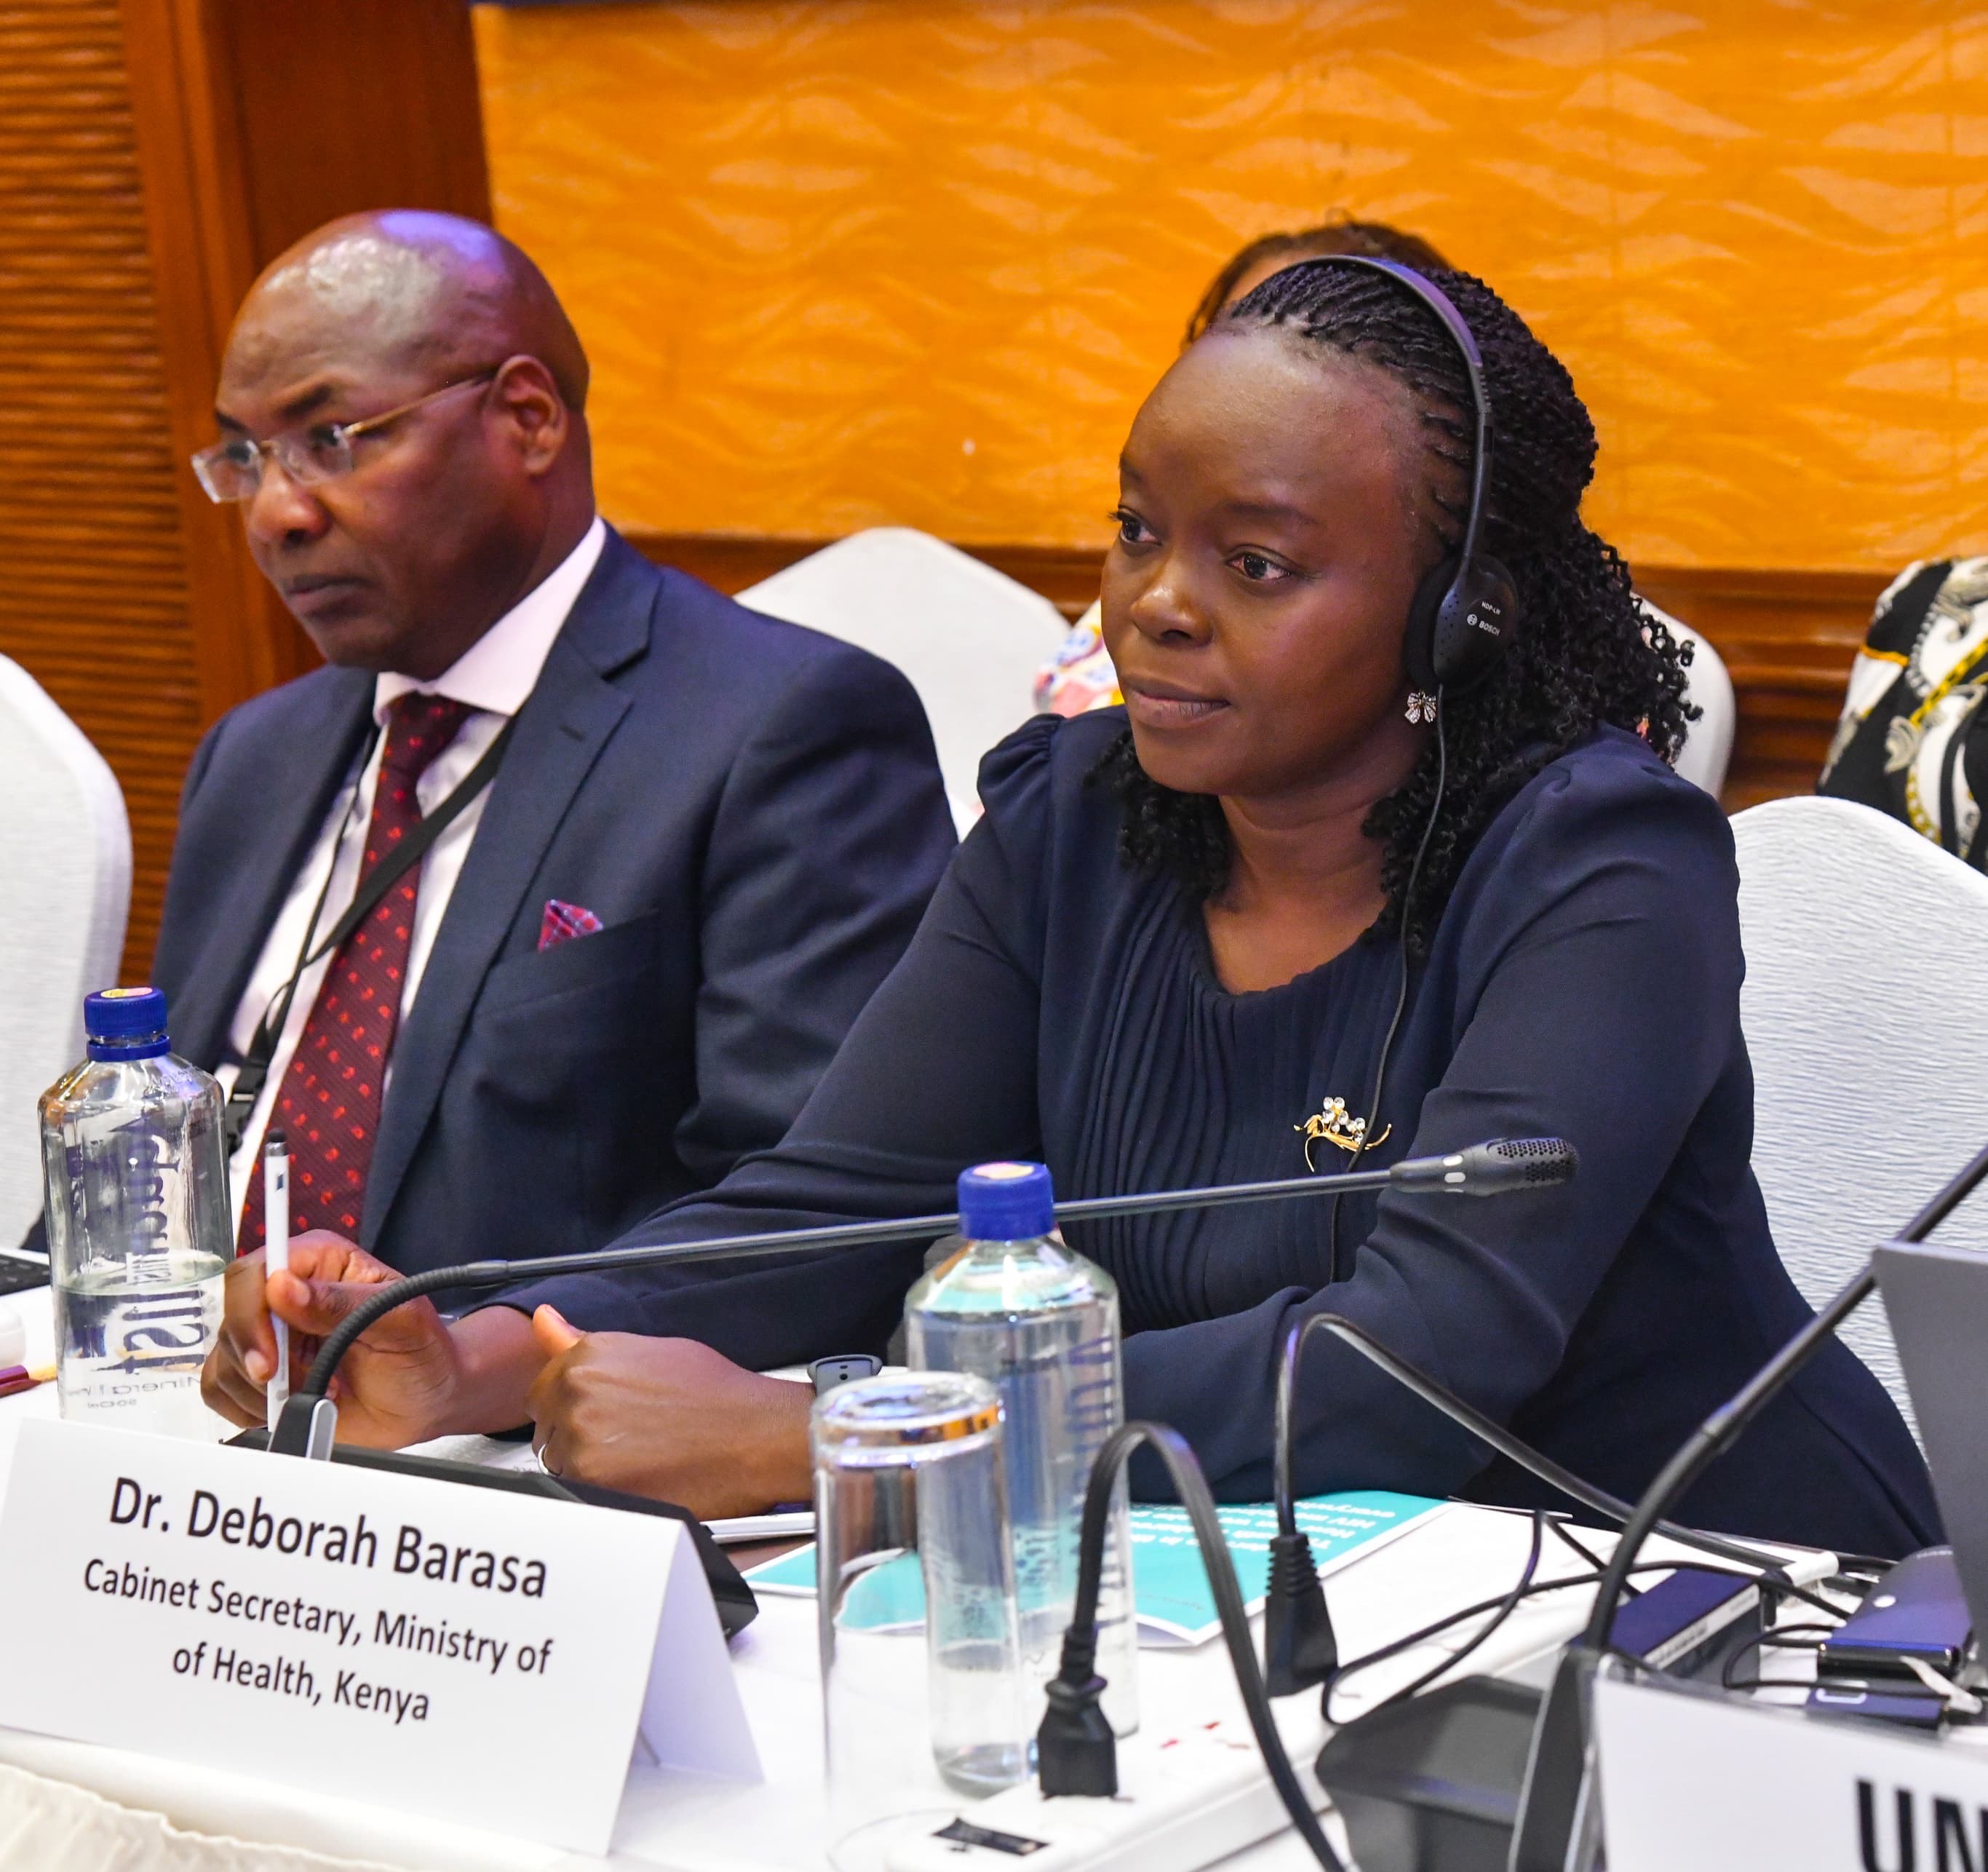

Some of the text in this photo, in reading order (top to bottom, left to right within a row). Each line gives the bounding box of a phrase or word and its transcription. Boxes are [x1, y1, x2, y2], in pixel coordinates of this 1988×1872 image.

[1479, 620, 1500, 635] BOSCH
[110, 1477, 546, 1598] Dr. Deborah Barasa
[84, 1558, 553, 1675] Cabinet Secretary, Ministry of
[173, 1641, 429, 1724] of Health, Kenya
